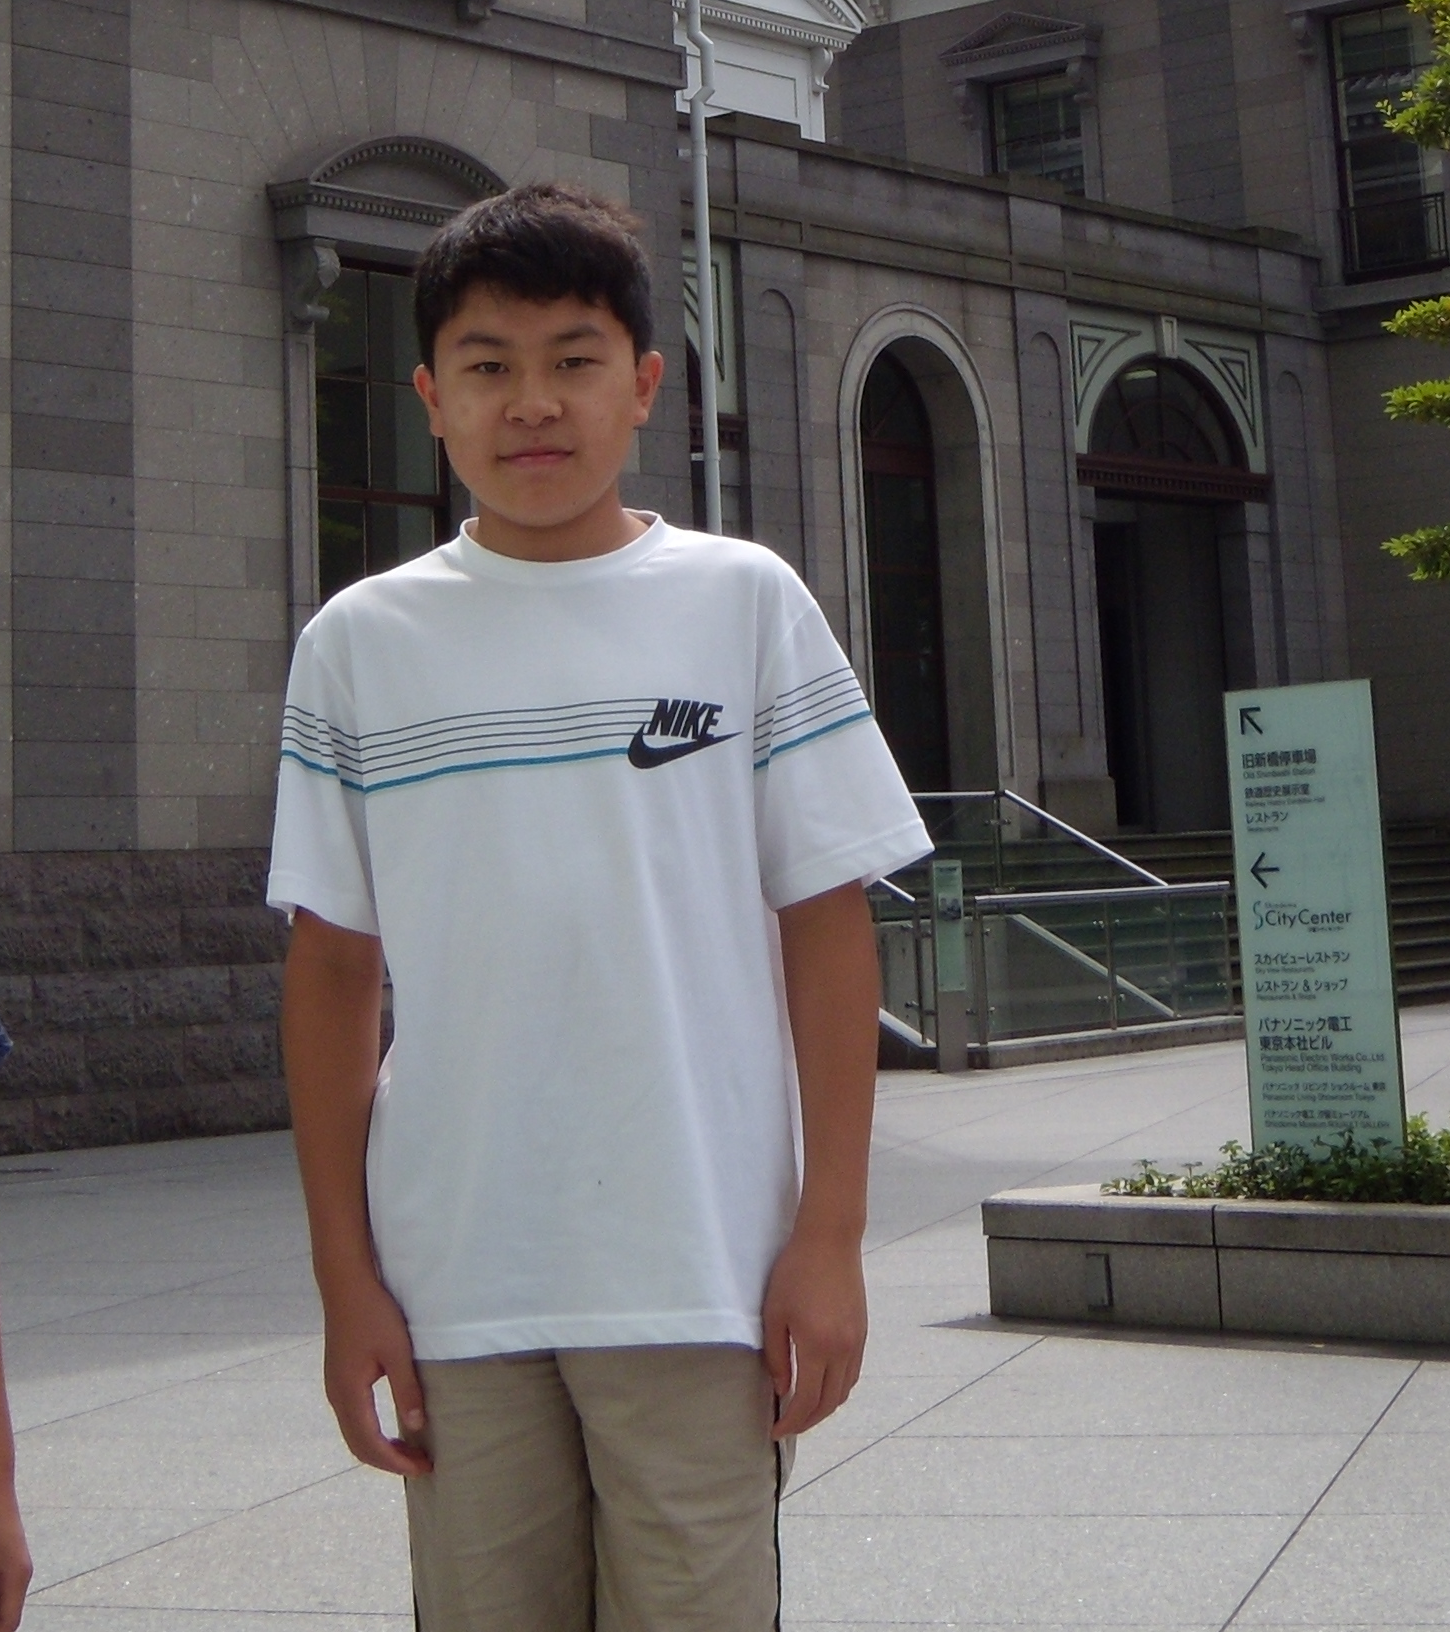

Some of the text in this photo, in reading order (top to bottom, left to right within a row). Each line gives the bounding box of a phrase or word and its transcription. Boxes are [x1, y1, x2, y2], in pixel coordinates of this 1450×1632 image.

[650, 698, 724, 740] NIKE
[1246, 812, 1289, 824] レストラン
[1254, 952, 1350, 966] スカイビューレストラン
[1255, 978, 1348, 993] レストラン & ショップ
[1258, 1016, 1352, 1033] パナソニック電工
[1259, 1035, 1333, 1051] 東京本社ビル
